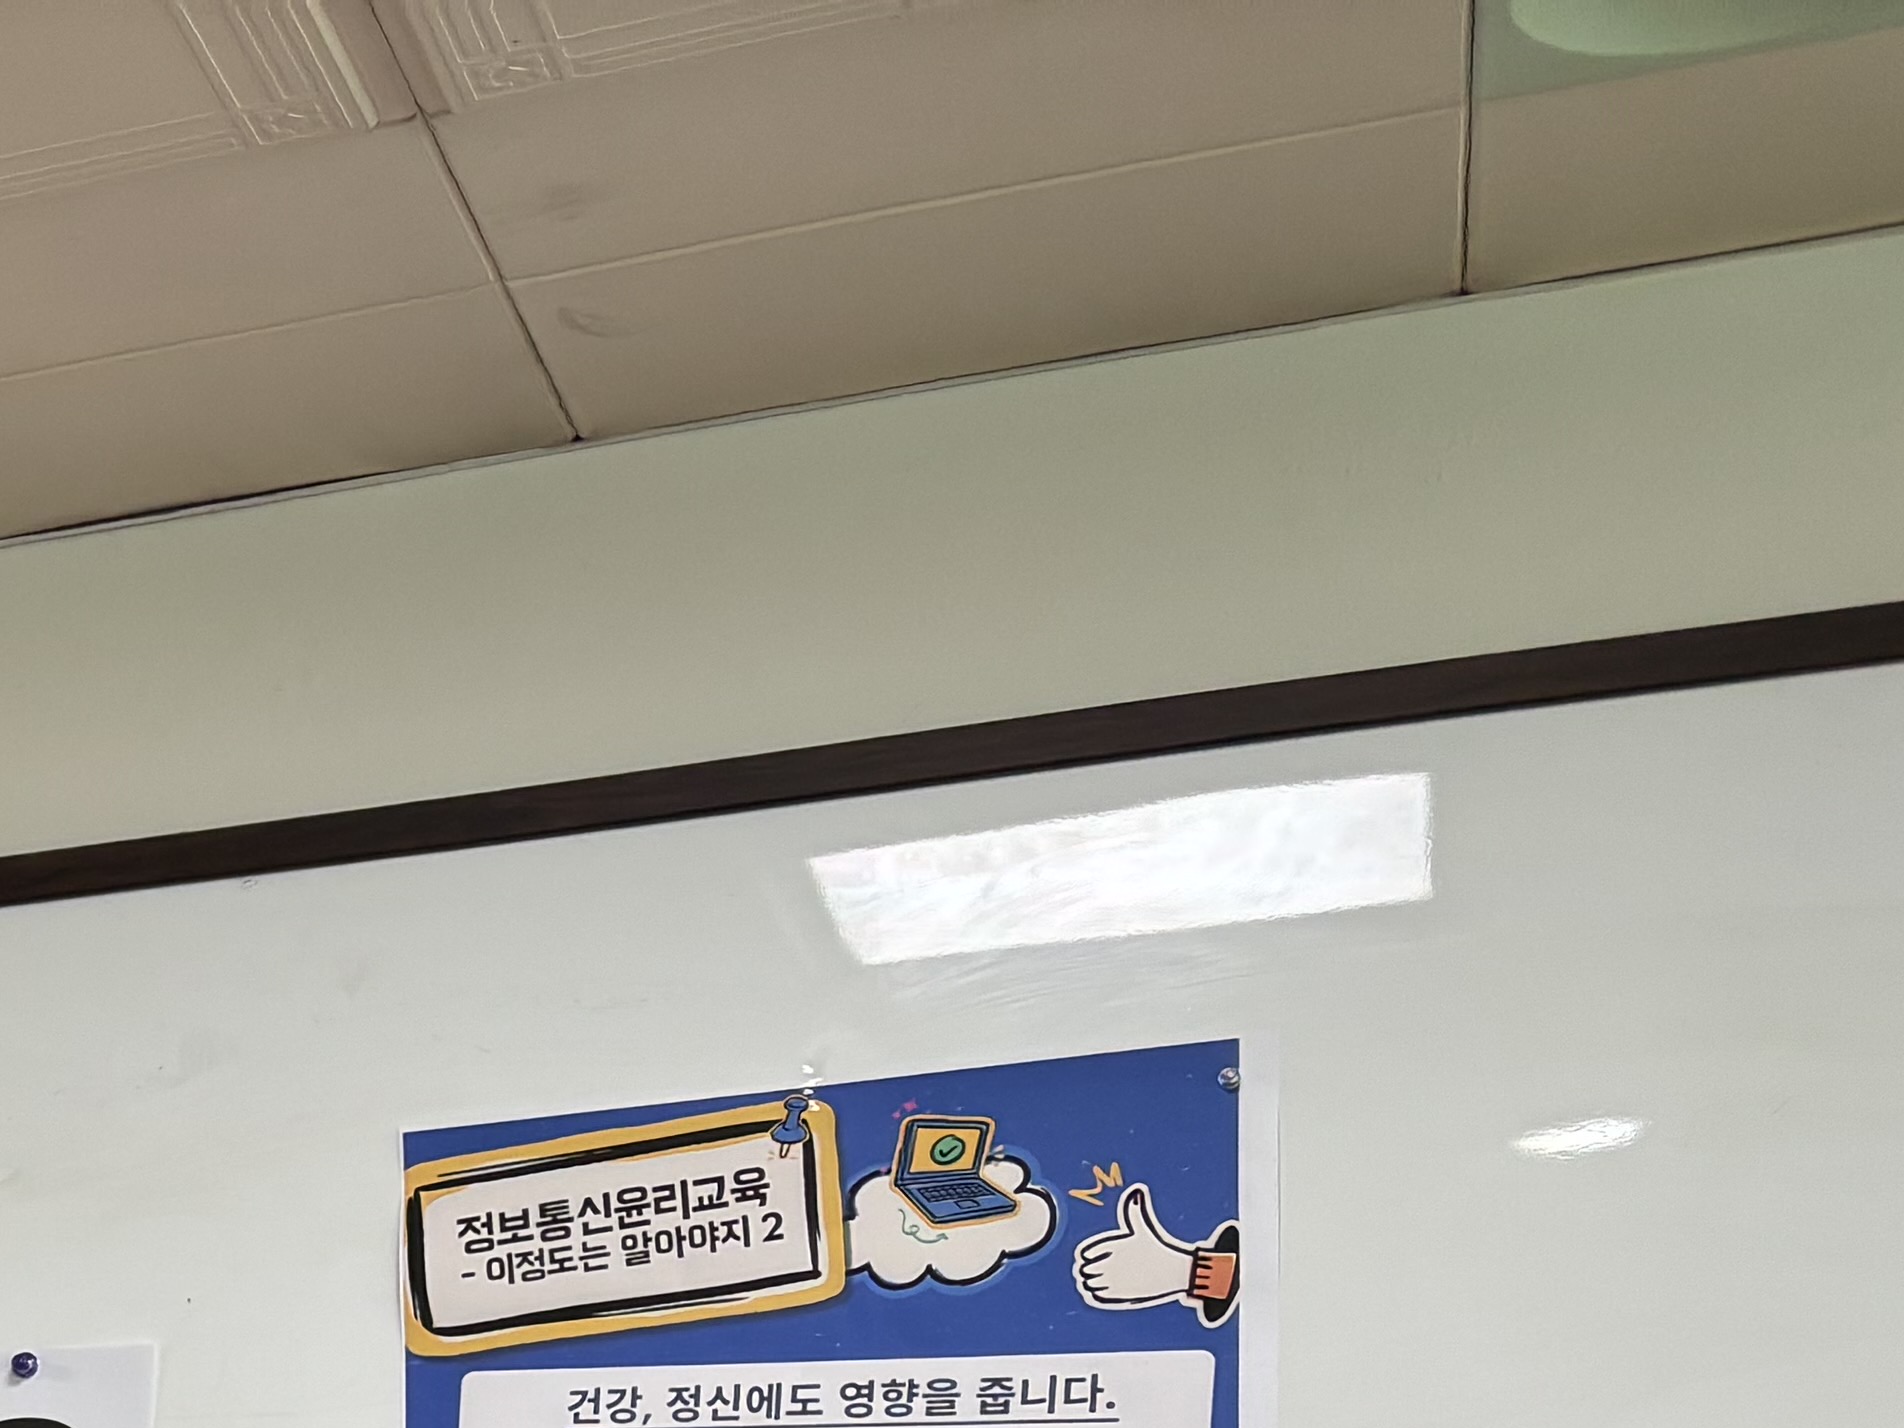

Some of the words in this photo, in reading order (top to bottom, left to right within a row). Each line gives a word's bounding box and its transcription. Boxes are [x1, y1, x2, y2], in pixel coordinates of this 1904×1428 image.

[456, 1166, 771, 1255] 정보통신윤리교육
[486, 1241, 611, 1284] 이정도는
[620, 1214, 751, 1267] 알아야지
[761, 1211, 784, 1242] 2
[567, 1388, 652, 1425] 건강,
[666, 1382, 824, 1422] 정신에도
[838, 1377, 961, 1418] 영향을
[976, 1374, 1116, 1416] 줍니다.
